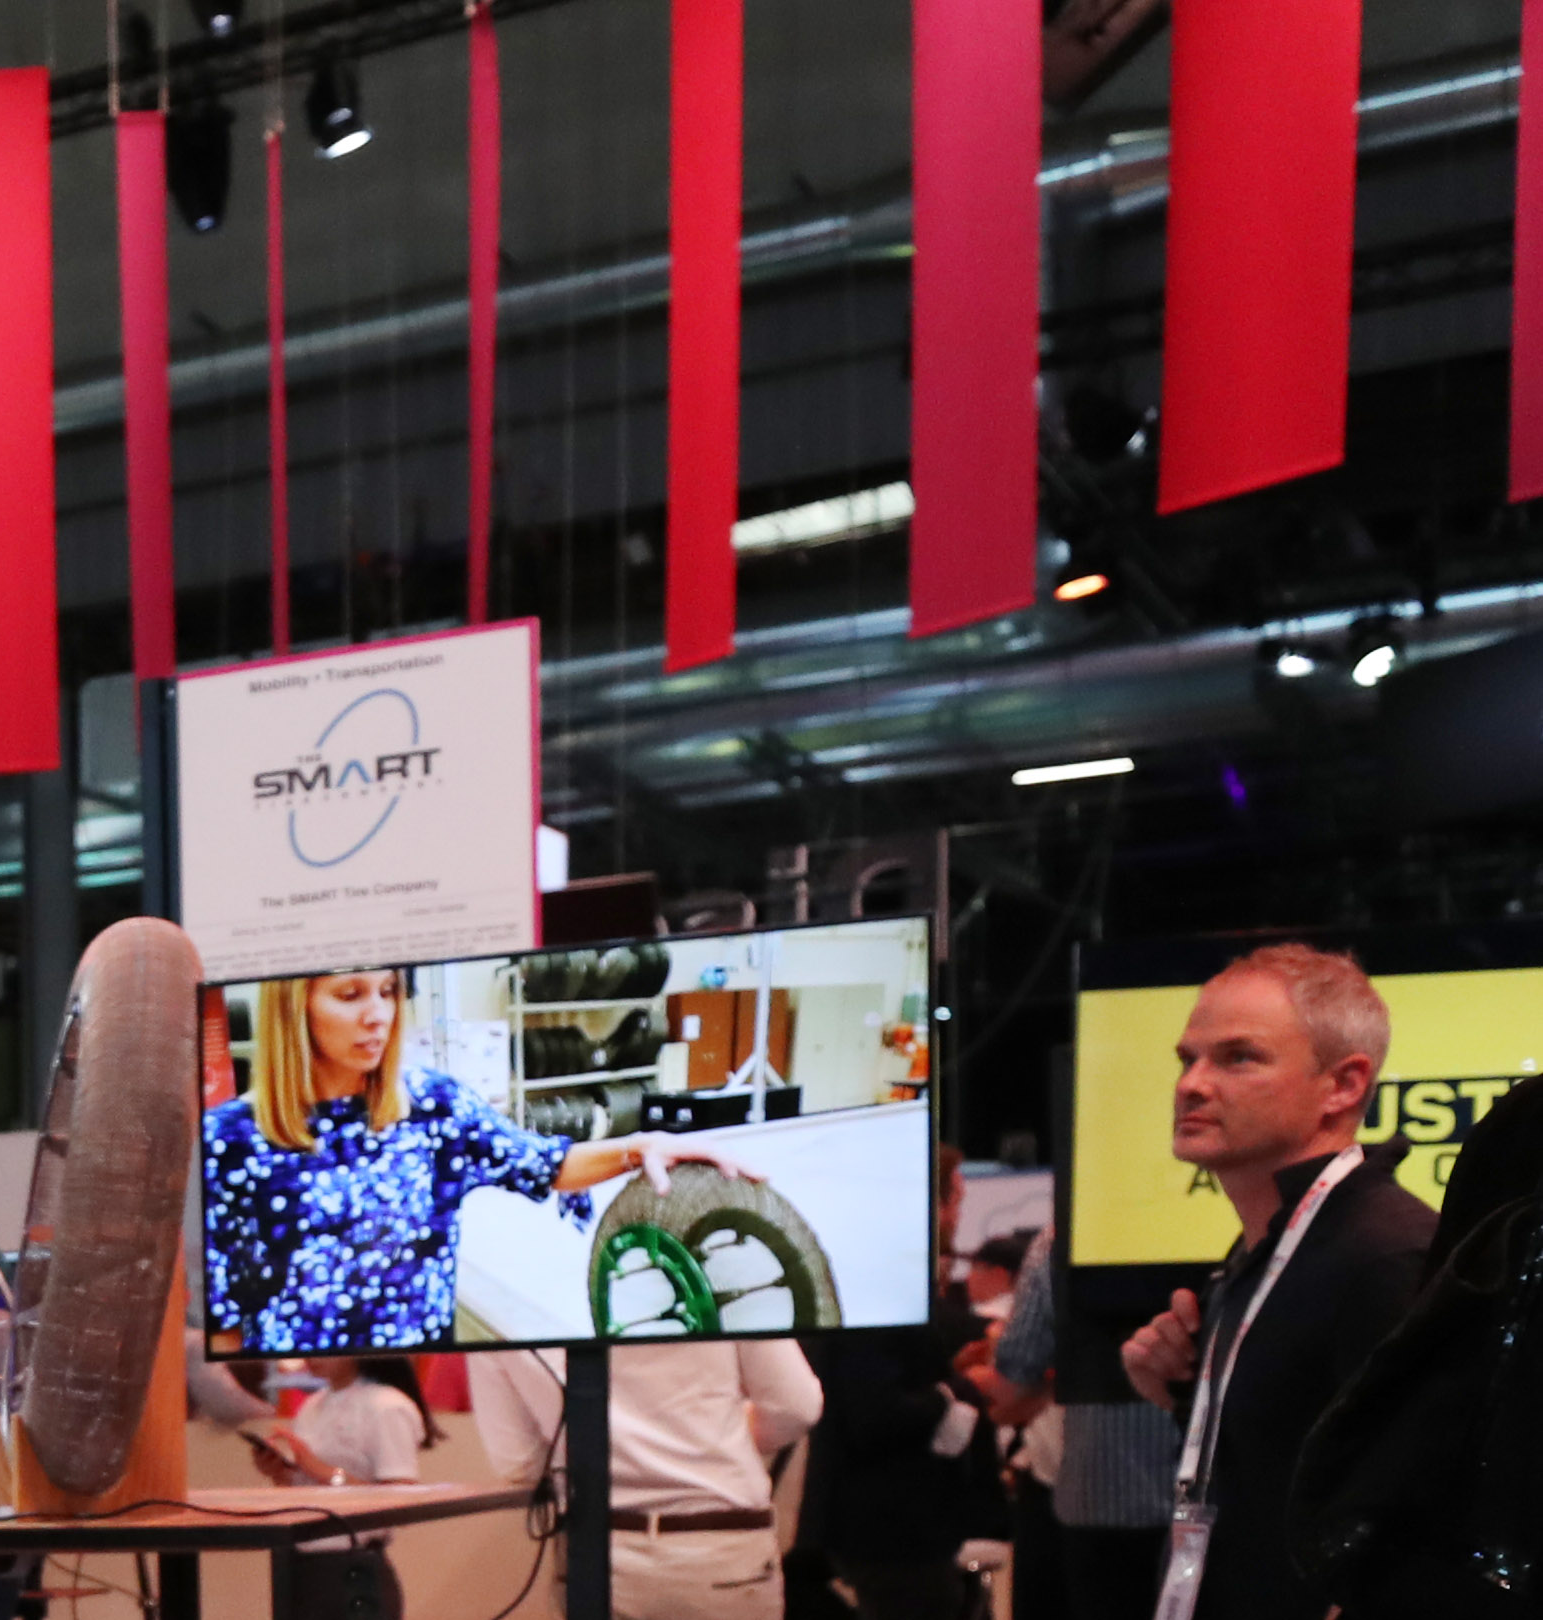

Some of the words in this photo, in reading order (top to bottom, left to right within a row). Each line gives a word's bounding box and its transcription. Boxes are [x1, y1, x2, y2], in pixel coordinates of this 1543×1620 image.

[249, 674, 308, 694] Mobility
[326, 654, 444, 682] Transportation
[252, 747, 443, 800] SMART
